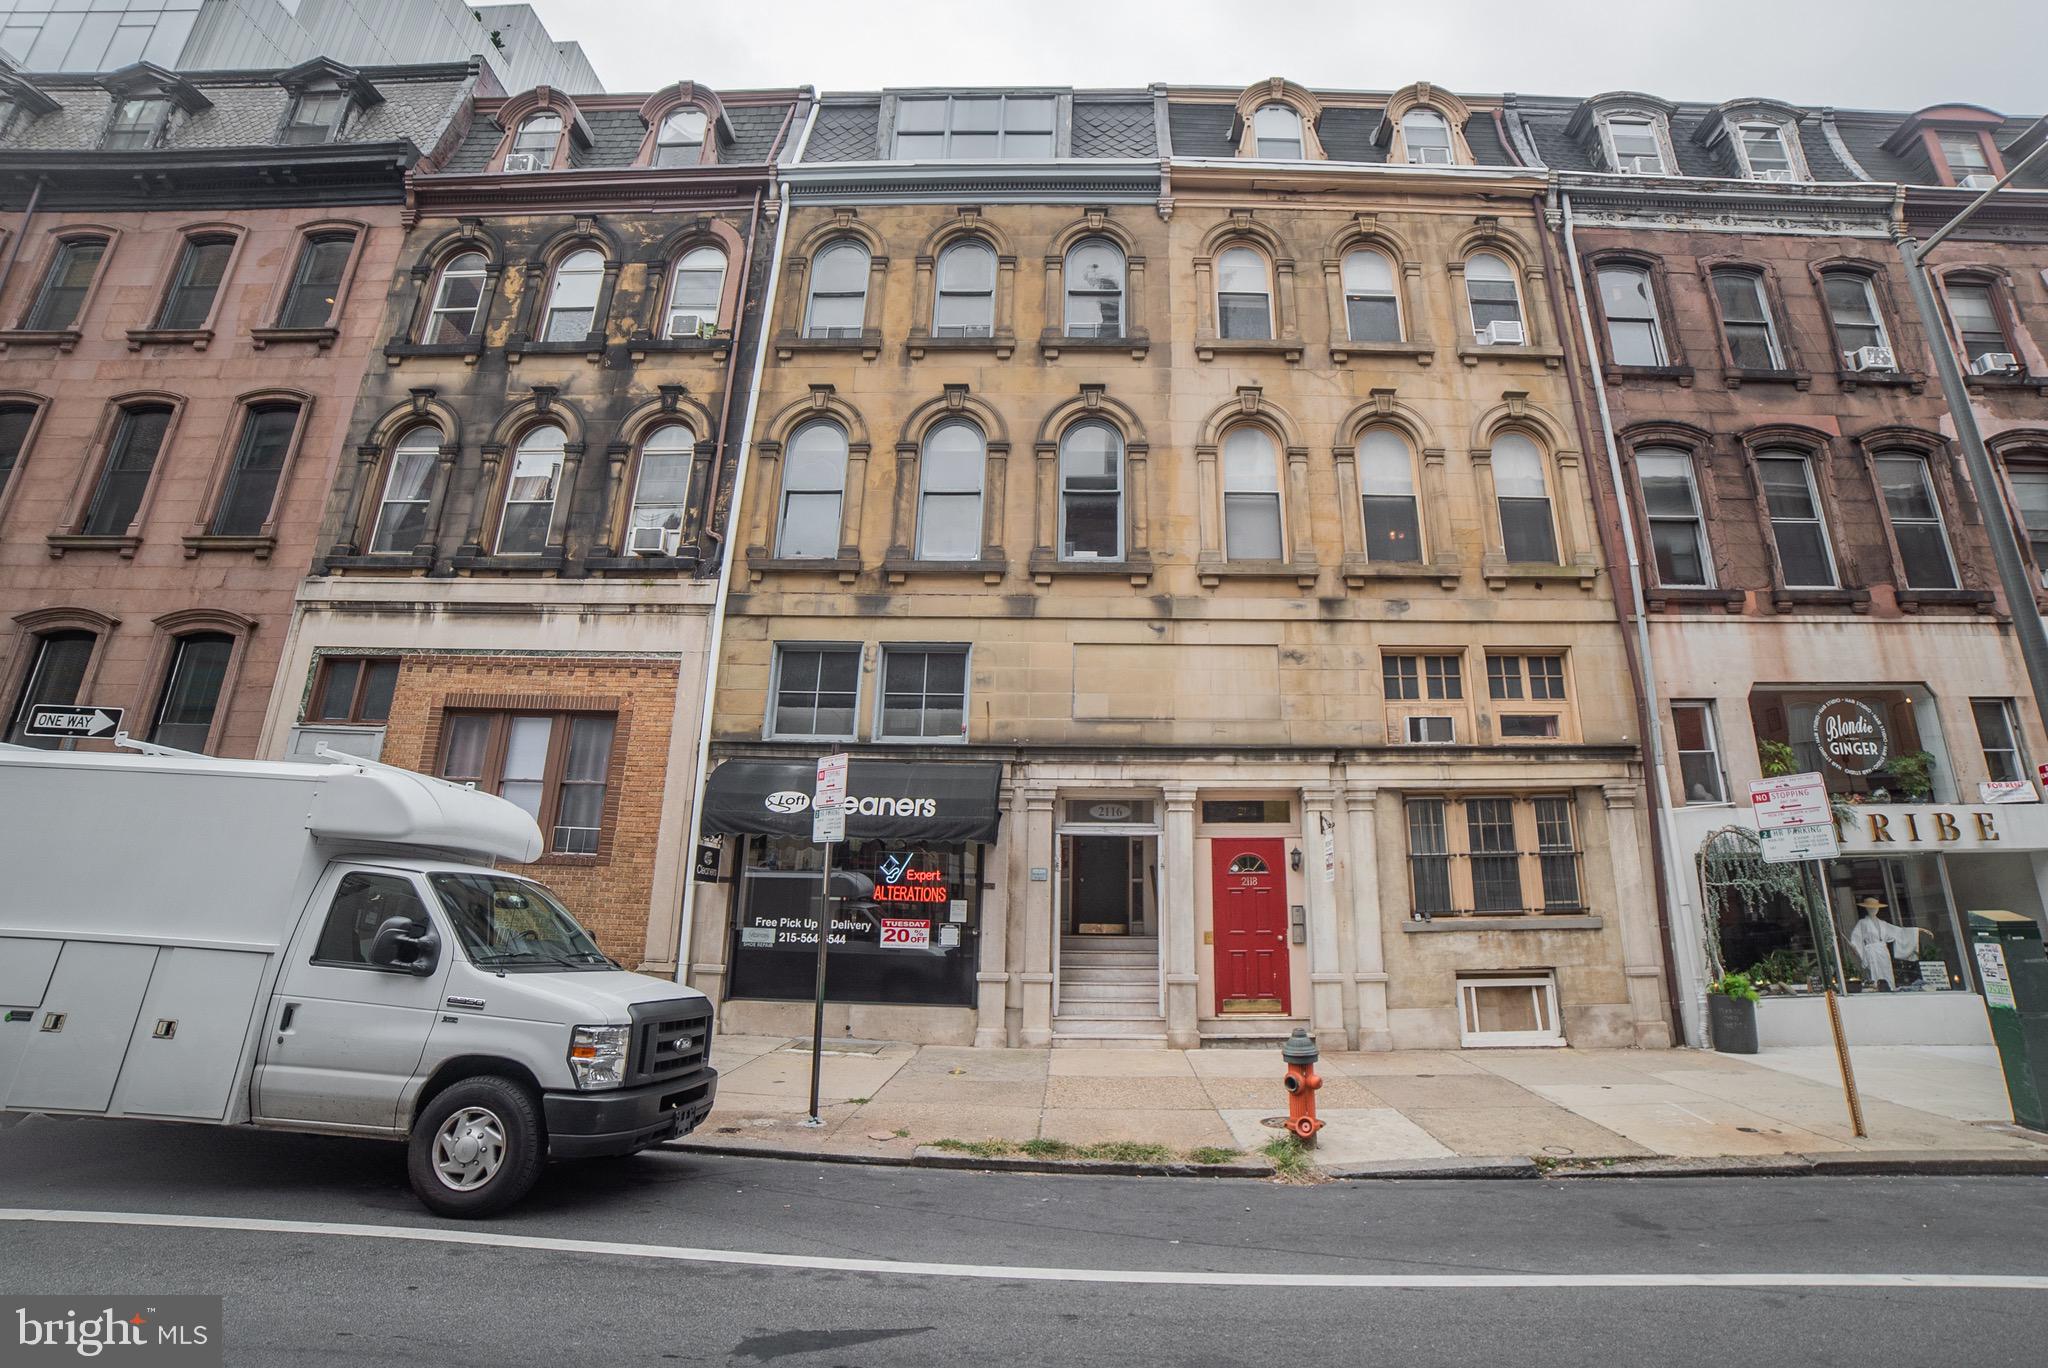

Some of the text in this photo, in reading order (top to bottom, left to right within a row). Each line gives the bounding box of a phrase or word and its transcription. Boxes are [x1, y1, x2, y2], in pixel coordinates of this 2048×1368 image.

[38, 714, 94, 728] ONE WAY
[1826, 714, 1873, 742] Blondie
[1830, 742, 1879, 755] GINGER
[778, 794, 806, 807] Loft
[1755, 788, 1810, 802] NO STOPPING
[1098, 806, 1122, 817] 2116
[1773, 829, 1785, 837] HR
[1788, 826, 1822, 836] PARKING
[906, 869, 942, 883] Expert
[1241, 876, 1258, 886] 2118
[873, 884, 947, 903] ALTERATIONS
[755, 917, 872, 933] Free Pick Up Delivery
[885, 920, 927, 928] TUESDAY
[778, 932, 847, 945] 215-564-544
[883, 928, 910, 943] 20
